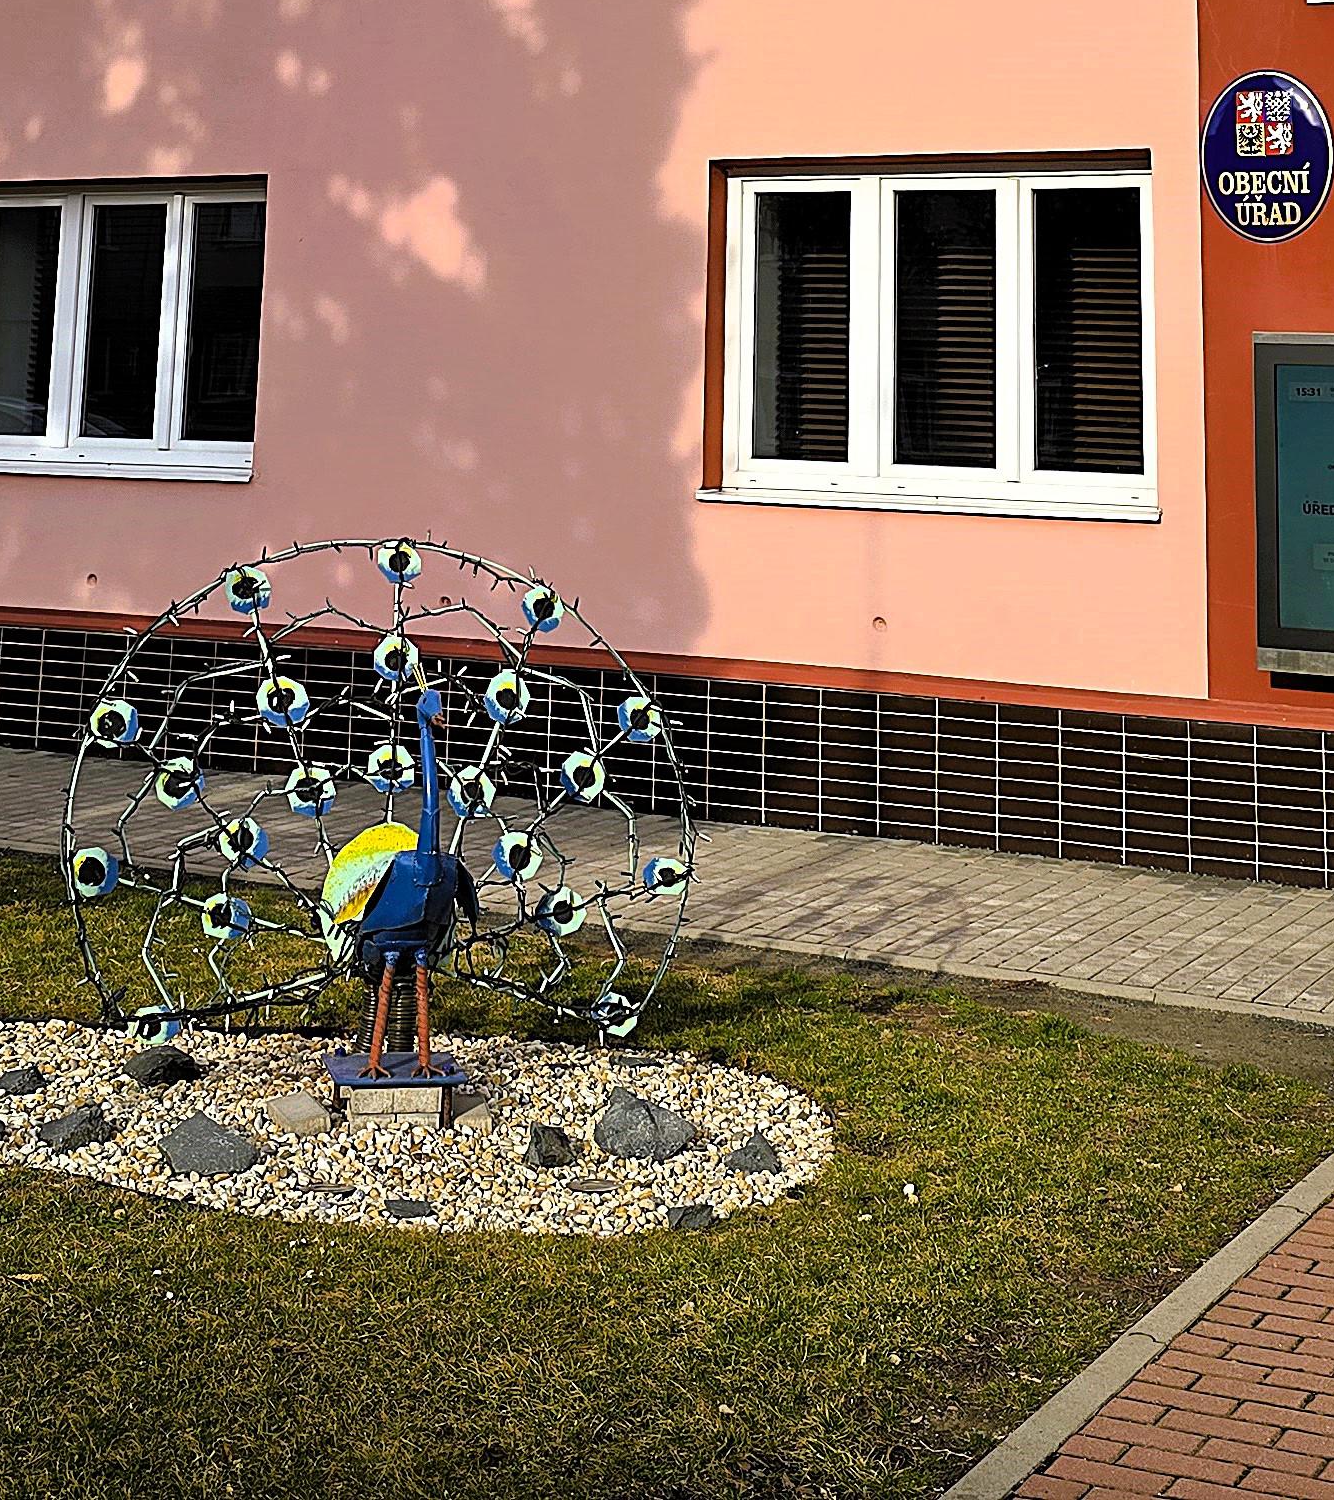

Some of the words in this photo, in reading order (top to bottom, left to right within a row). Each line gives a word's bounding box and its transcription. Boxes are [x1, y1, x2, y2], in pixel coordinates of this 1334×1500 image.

[1218, 162, 1310, 196] OBECNÍ
[1235, 195, 1302, 226] ÚŘAD
[1295, 387, 1321, 397] 15:31
